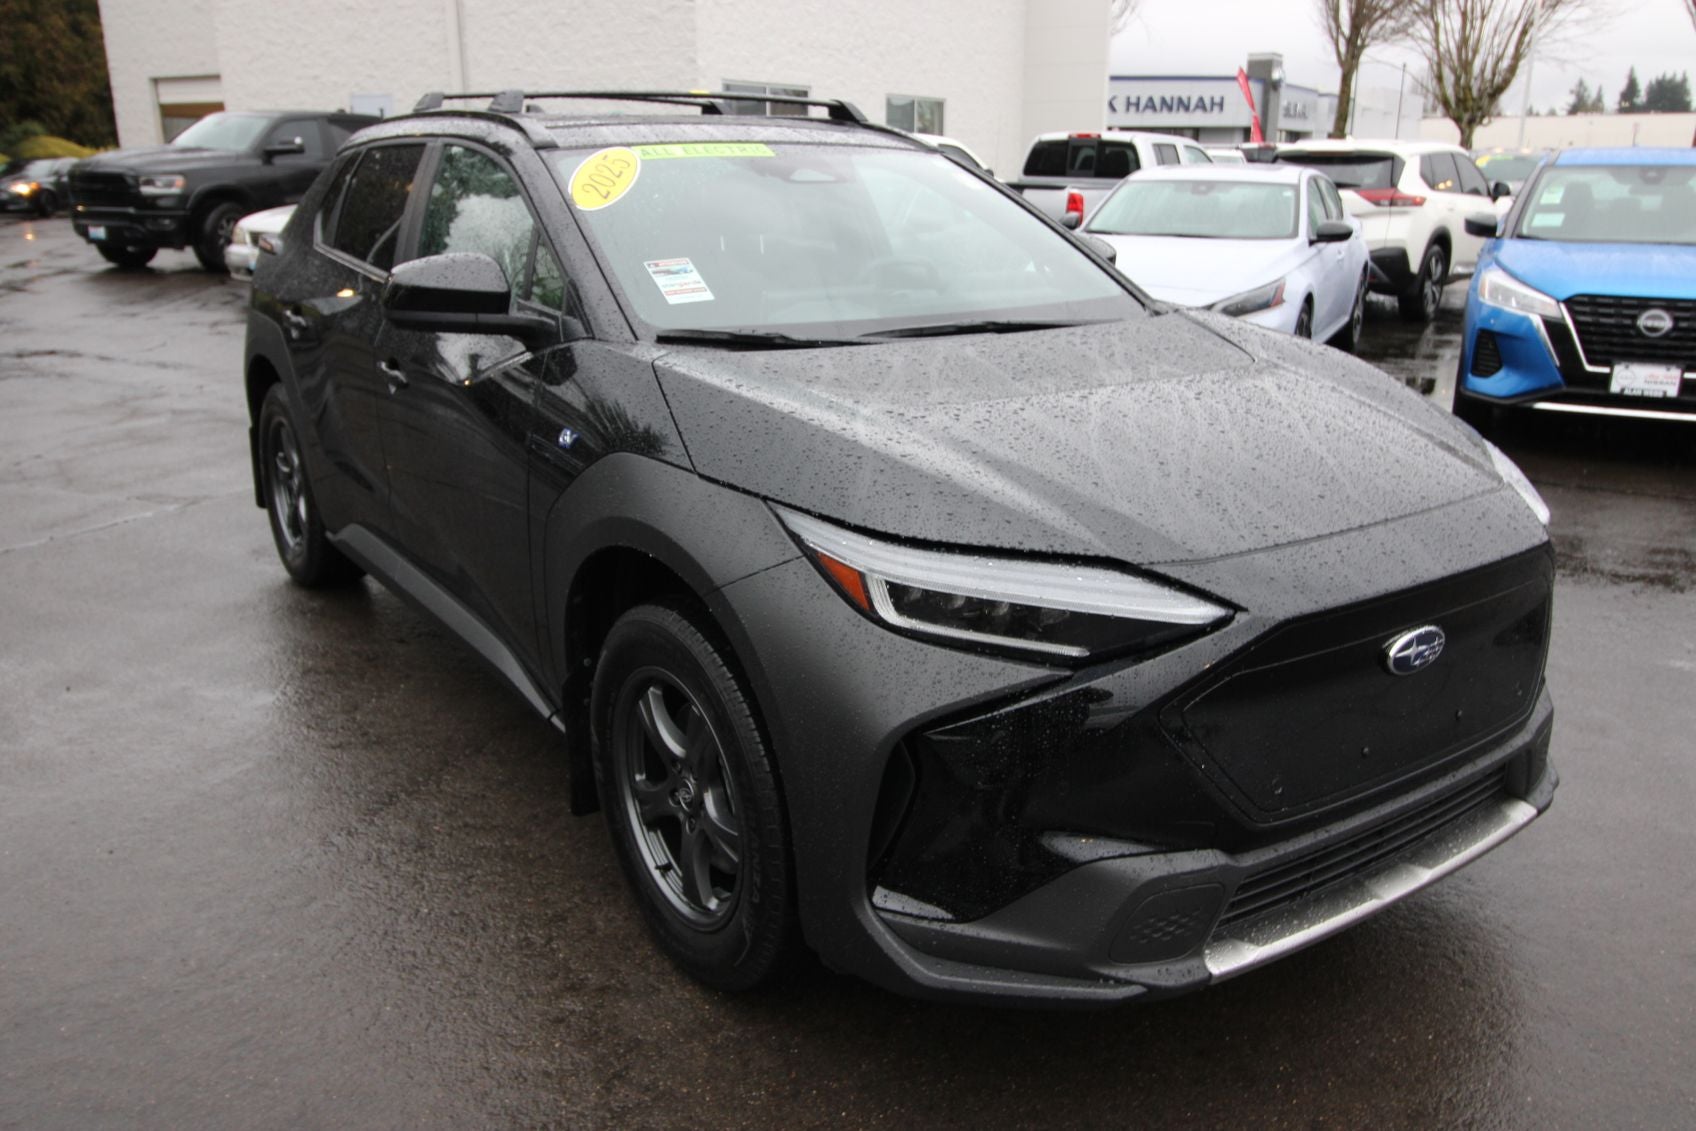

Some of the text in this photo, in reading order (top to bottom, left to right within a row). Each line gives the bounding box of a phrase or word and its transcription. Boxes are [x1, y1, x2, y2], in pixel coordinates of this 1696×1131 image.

[1125, 95, 1225, 113] HANNAH
[640, 147, 674, 158] ALL
[582, 154, 631, 199] 2025
